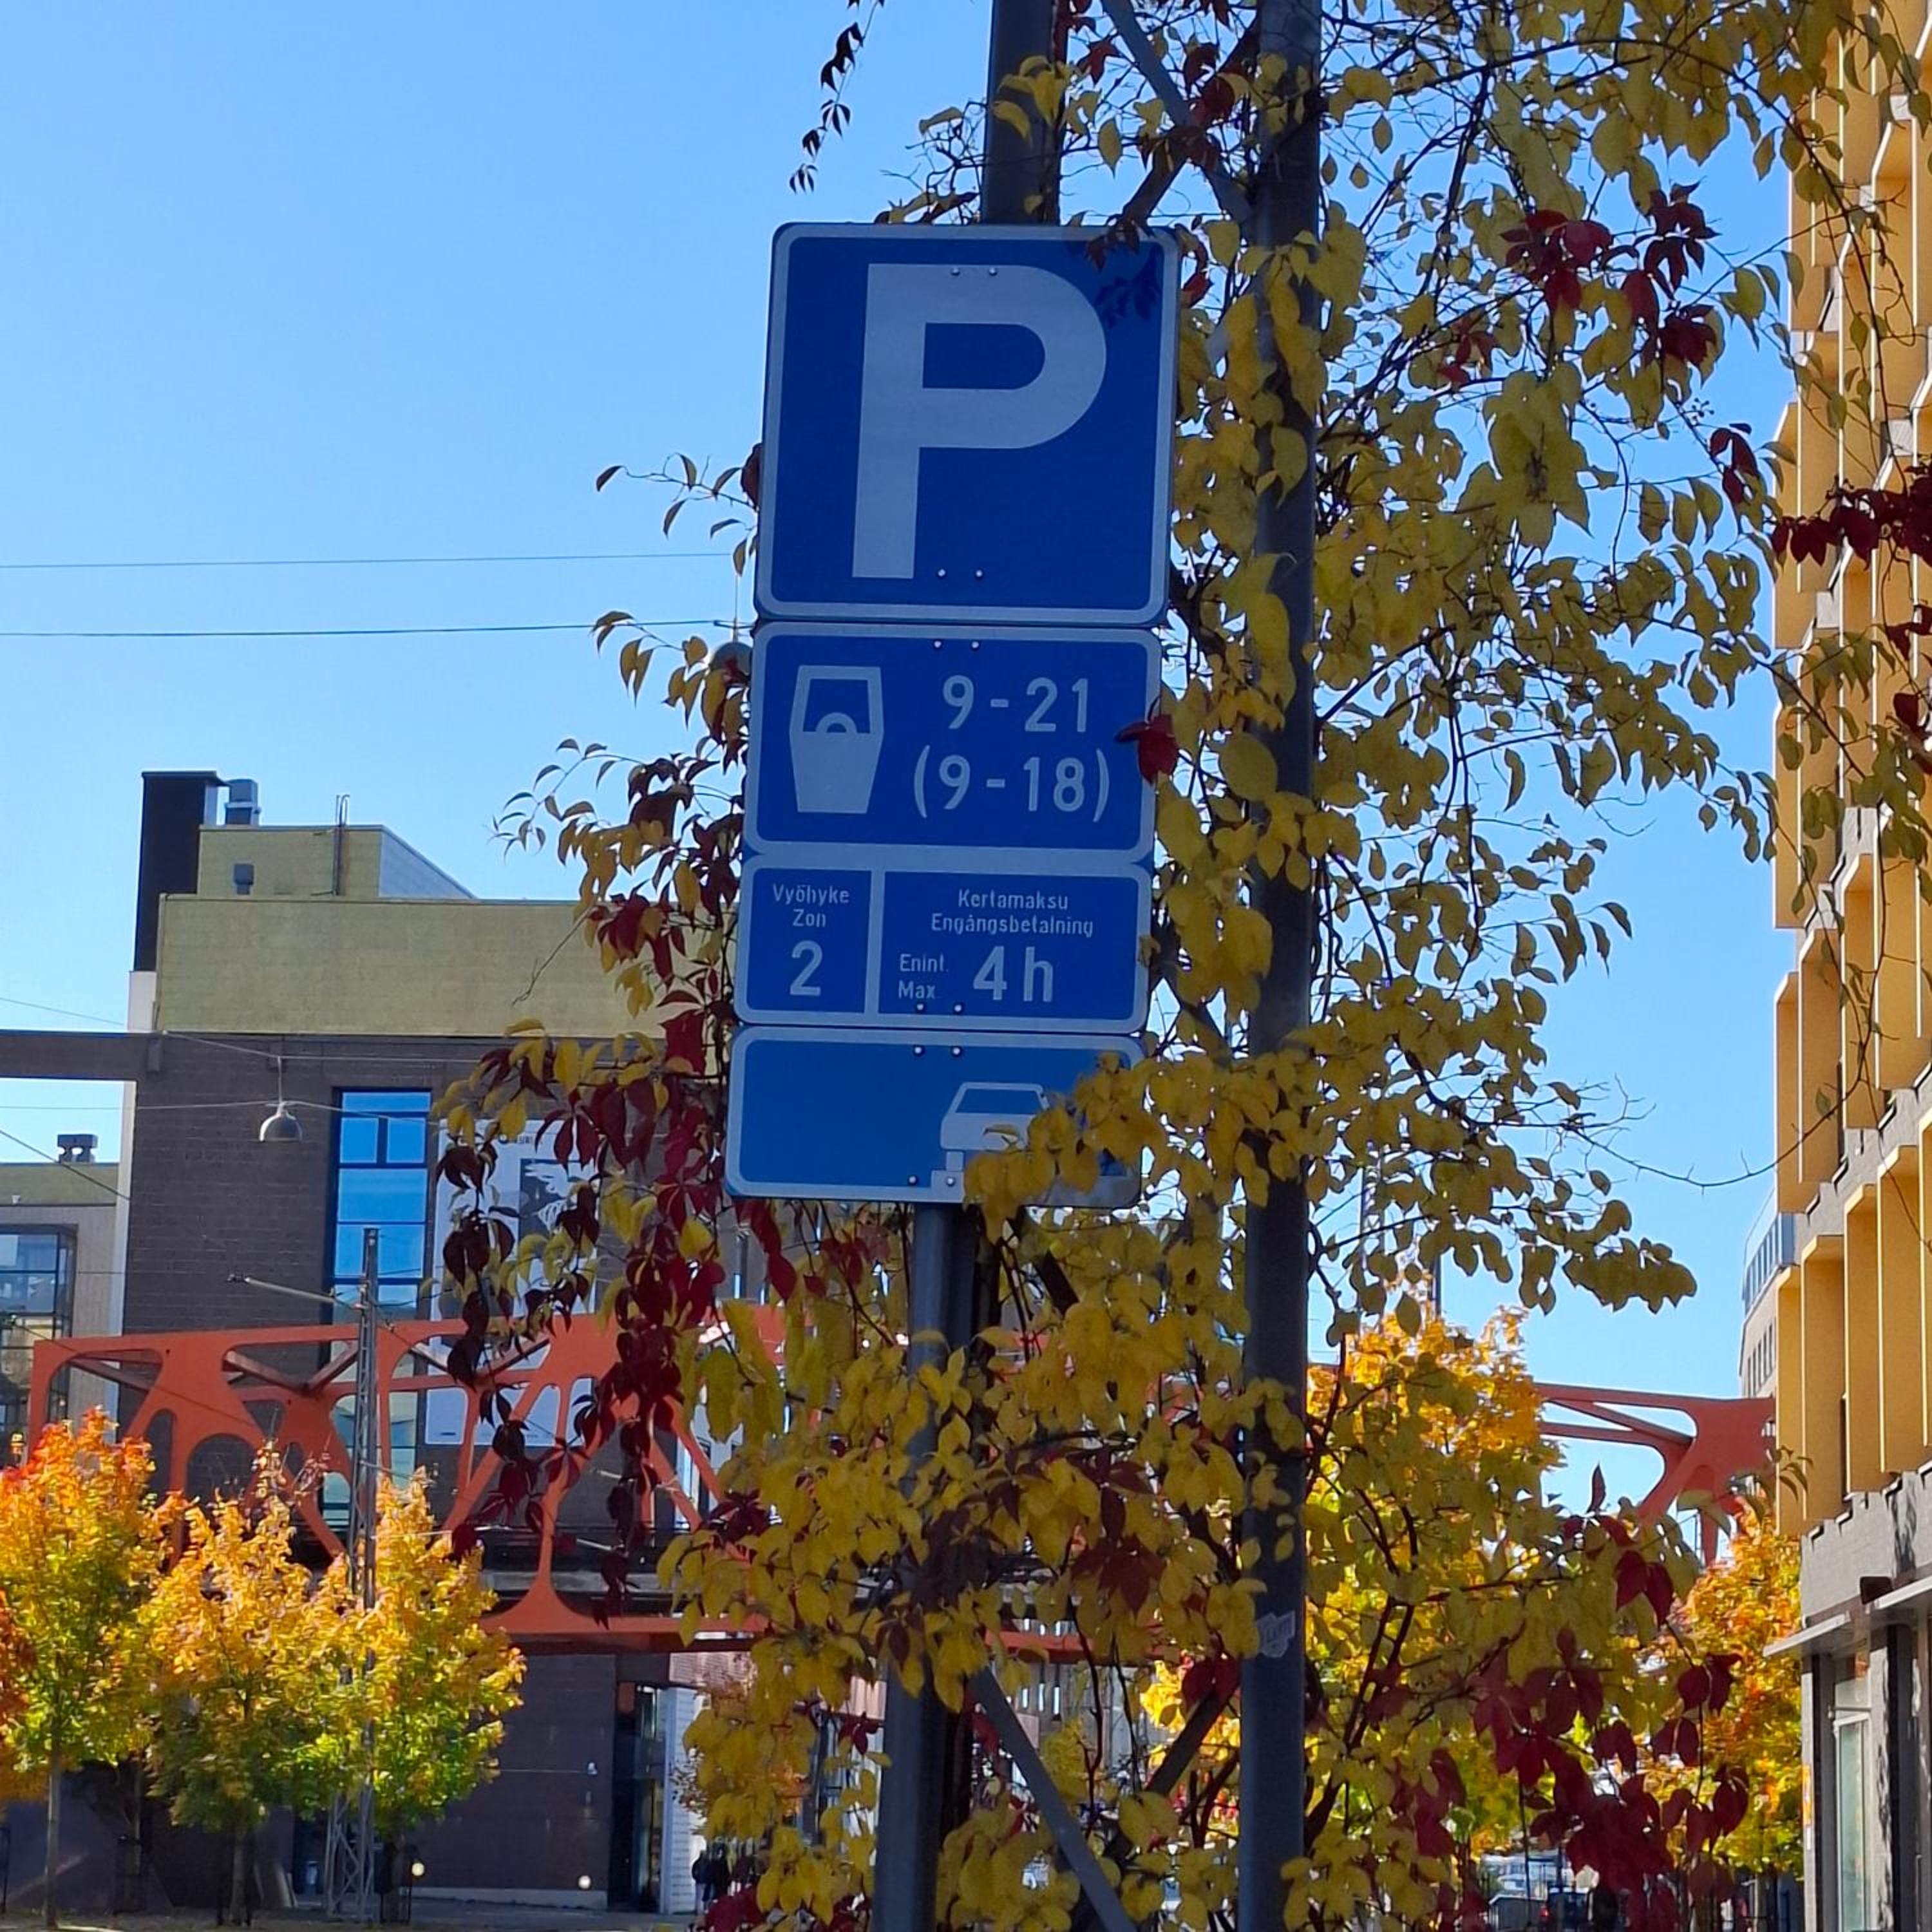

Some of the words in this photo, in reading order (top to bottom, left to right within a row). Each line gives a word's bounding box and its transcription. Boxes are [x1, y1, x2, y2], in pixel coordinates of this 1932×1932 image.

[852, 263, 1106, 579] P
[773, 884, 849, 906] Vyöhyke
[958, 888, 1068, 910] Kertamaksu
[793, 909, 826, 928] Zon
[931, 913, 1093, 938] Engångsbetalning
[790, 940, 822, 996] 2
[898, 980, 935, 999] Max
